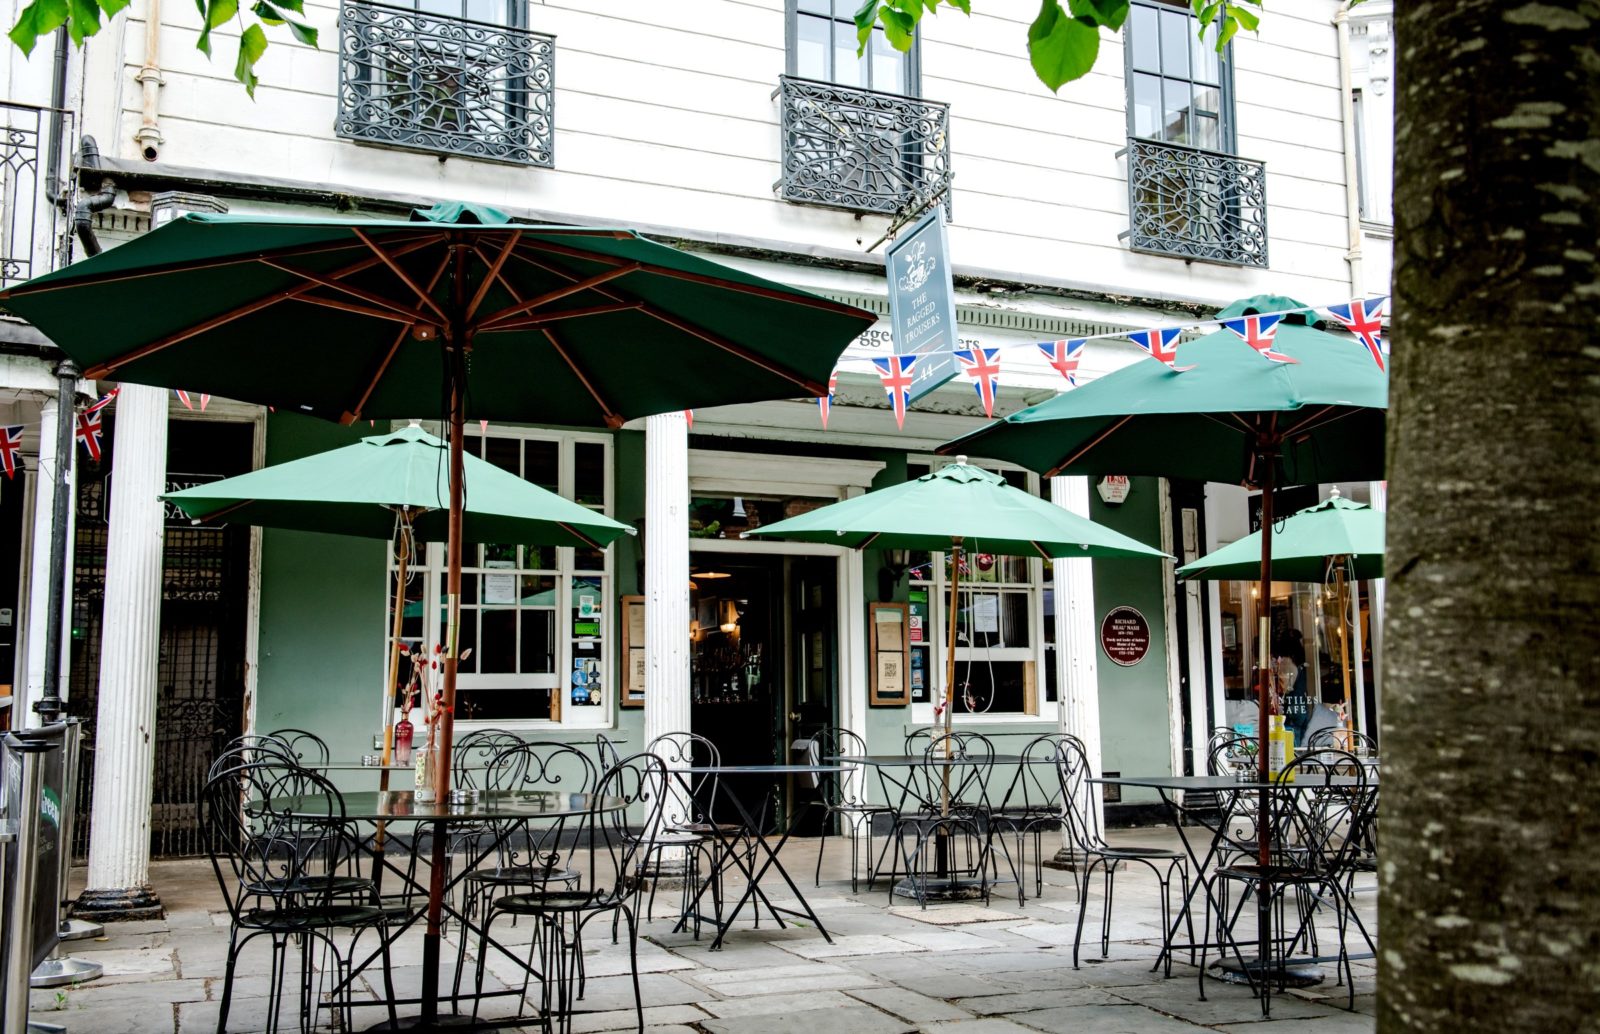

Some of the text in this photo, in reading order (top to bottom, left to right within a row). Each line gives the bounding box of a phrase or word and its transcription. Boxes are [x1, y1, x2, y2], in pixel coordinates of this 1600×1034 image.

[912, 292, 928, 310] THE
[907, 301, 936, 328] RAGGED
[905, 313, 941, 344] TROUSERS
[920, 363, 934, 381] 44
[1277, 695, 1319, 705] NTILES
